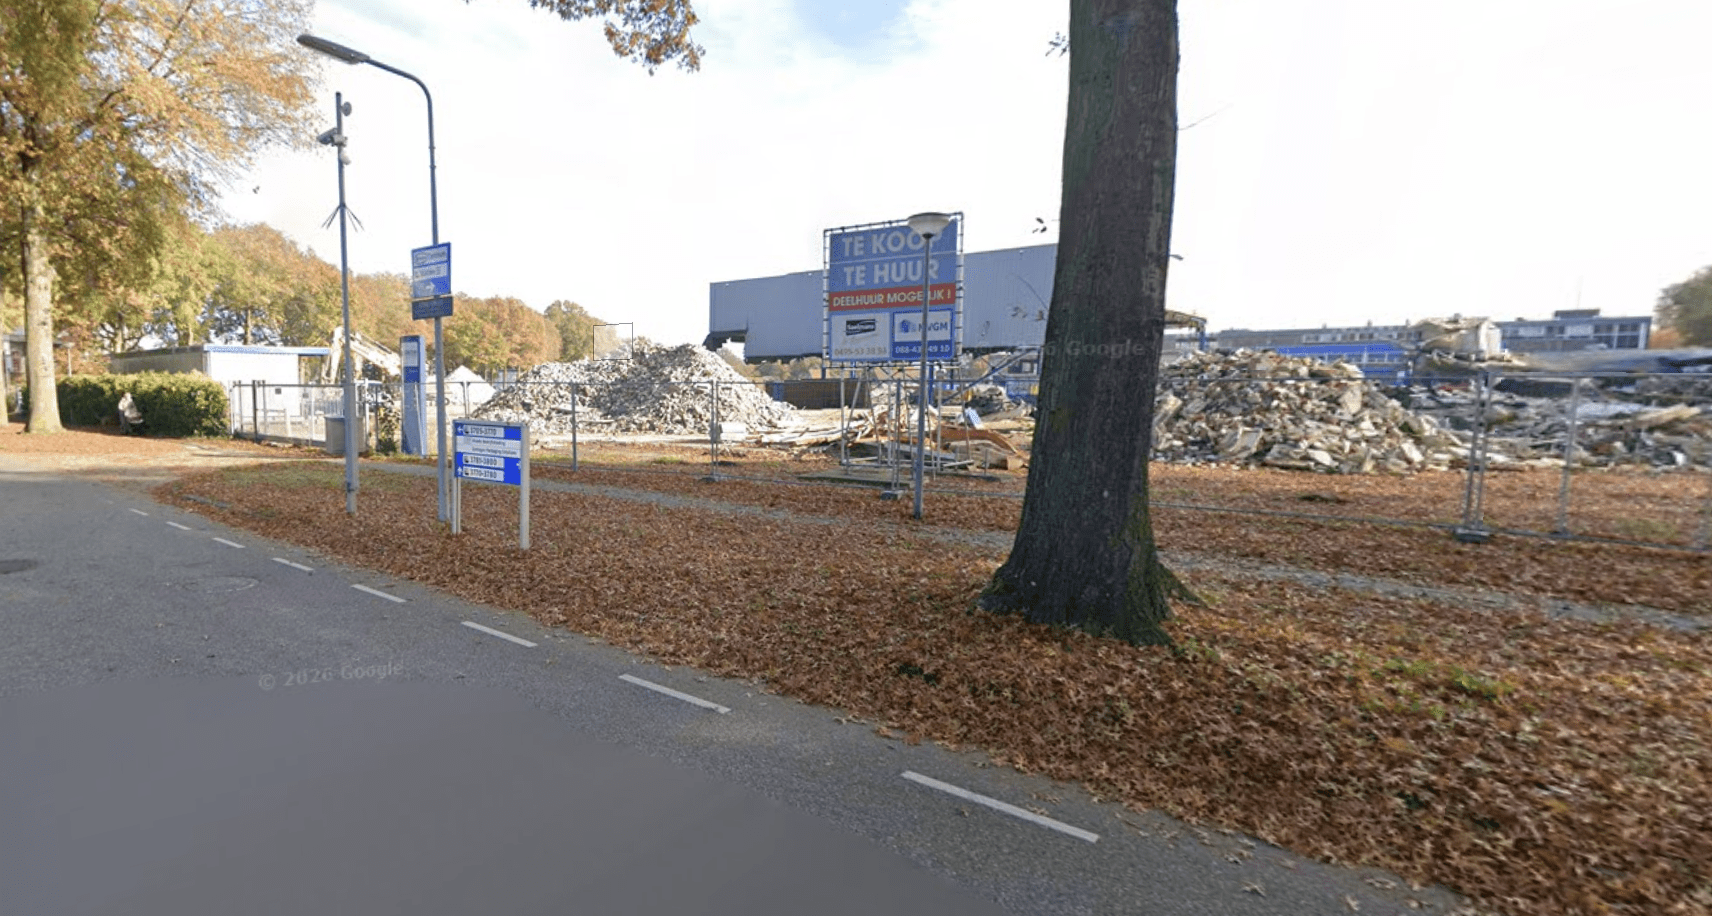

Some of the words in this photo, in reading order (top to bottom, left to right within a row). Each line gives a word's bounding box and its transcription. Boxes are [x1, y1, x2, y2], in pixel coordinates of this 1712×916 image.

[842, 235, 865, 257] TE
[844, 264, 866, 286] TE
[873, 259, 940, 285] HUUR
[832, 293, 884, 307] DEELHUUR
